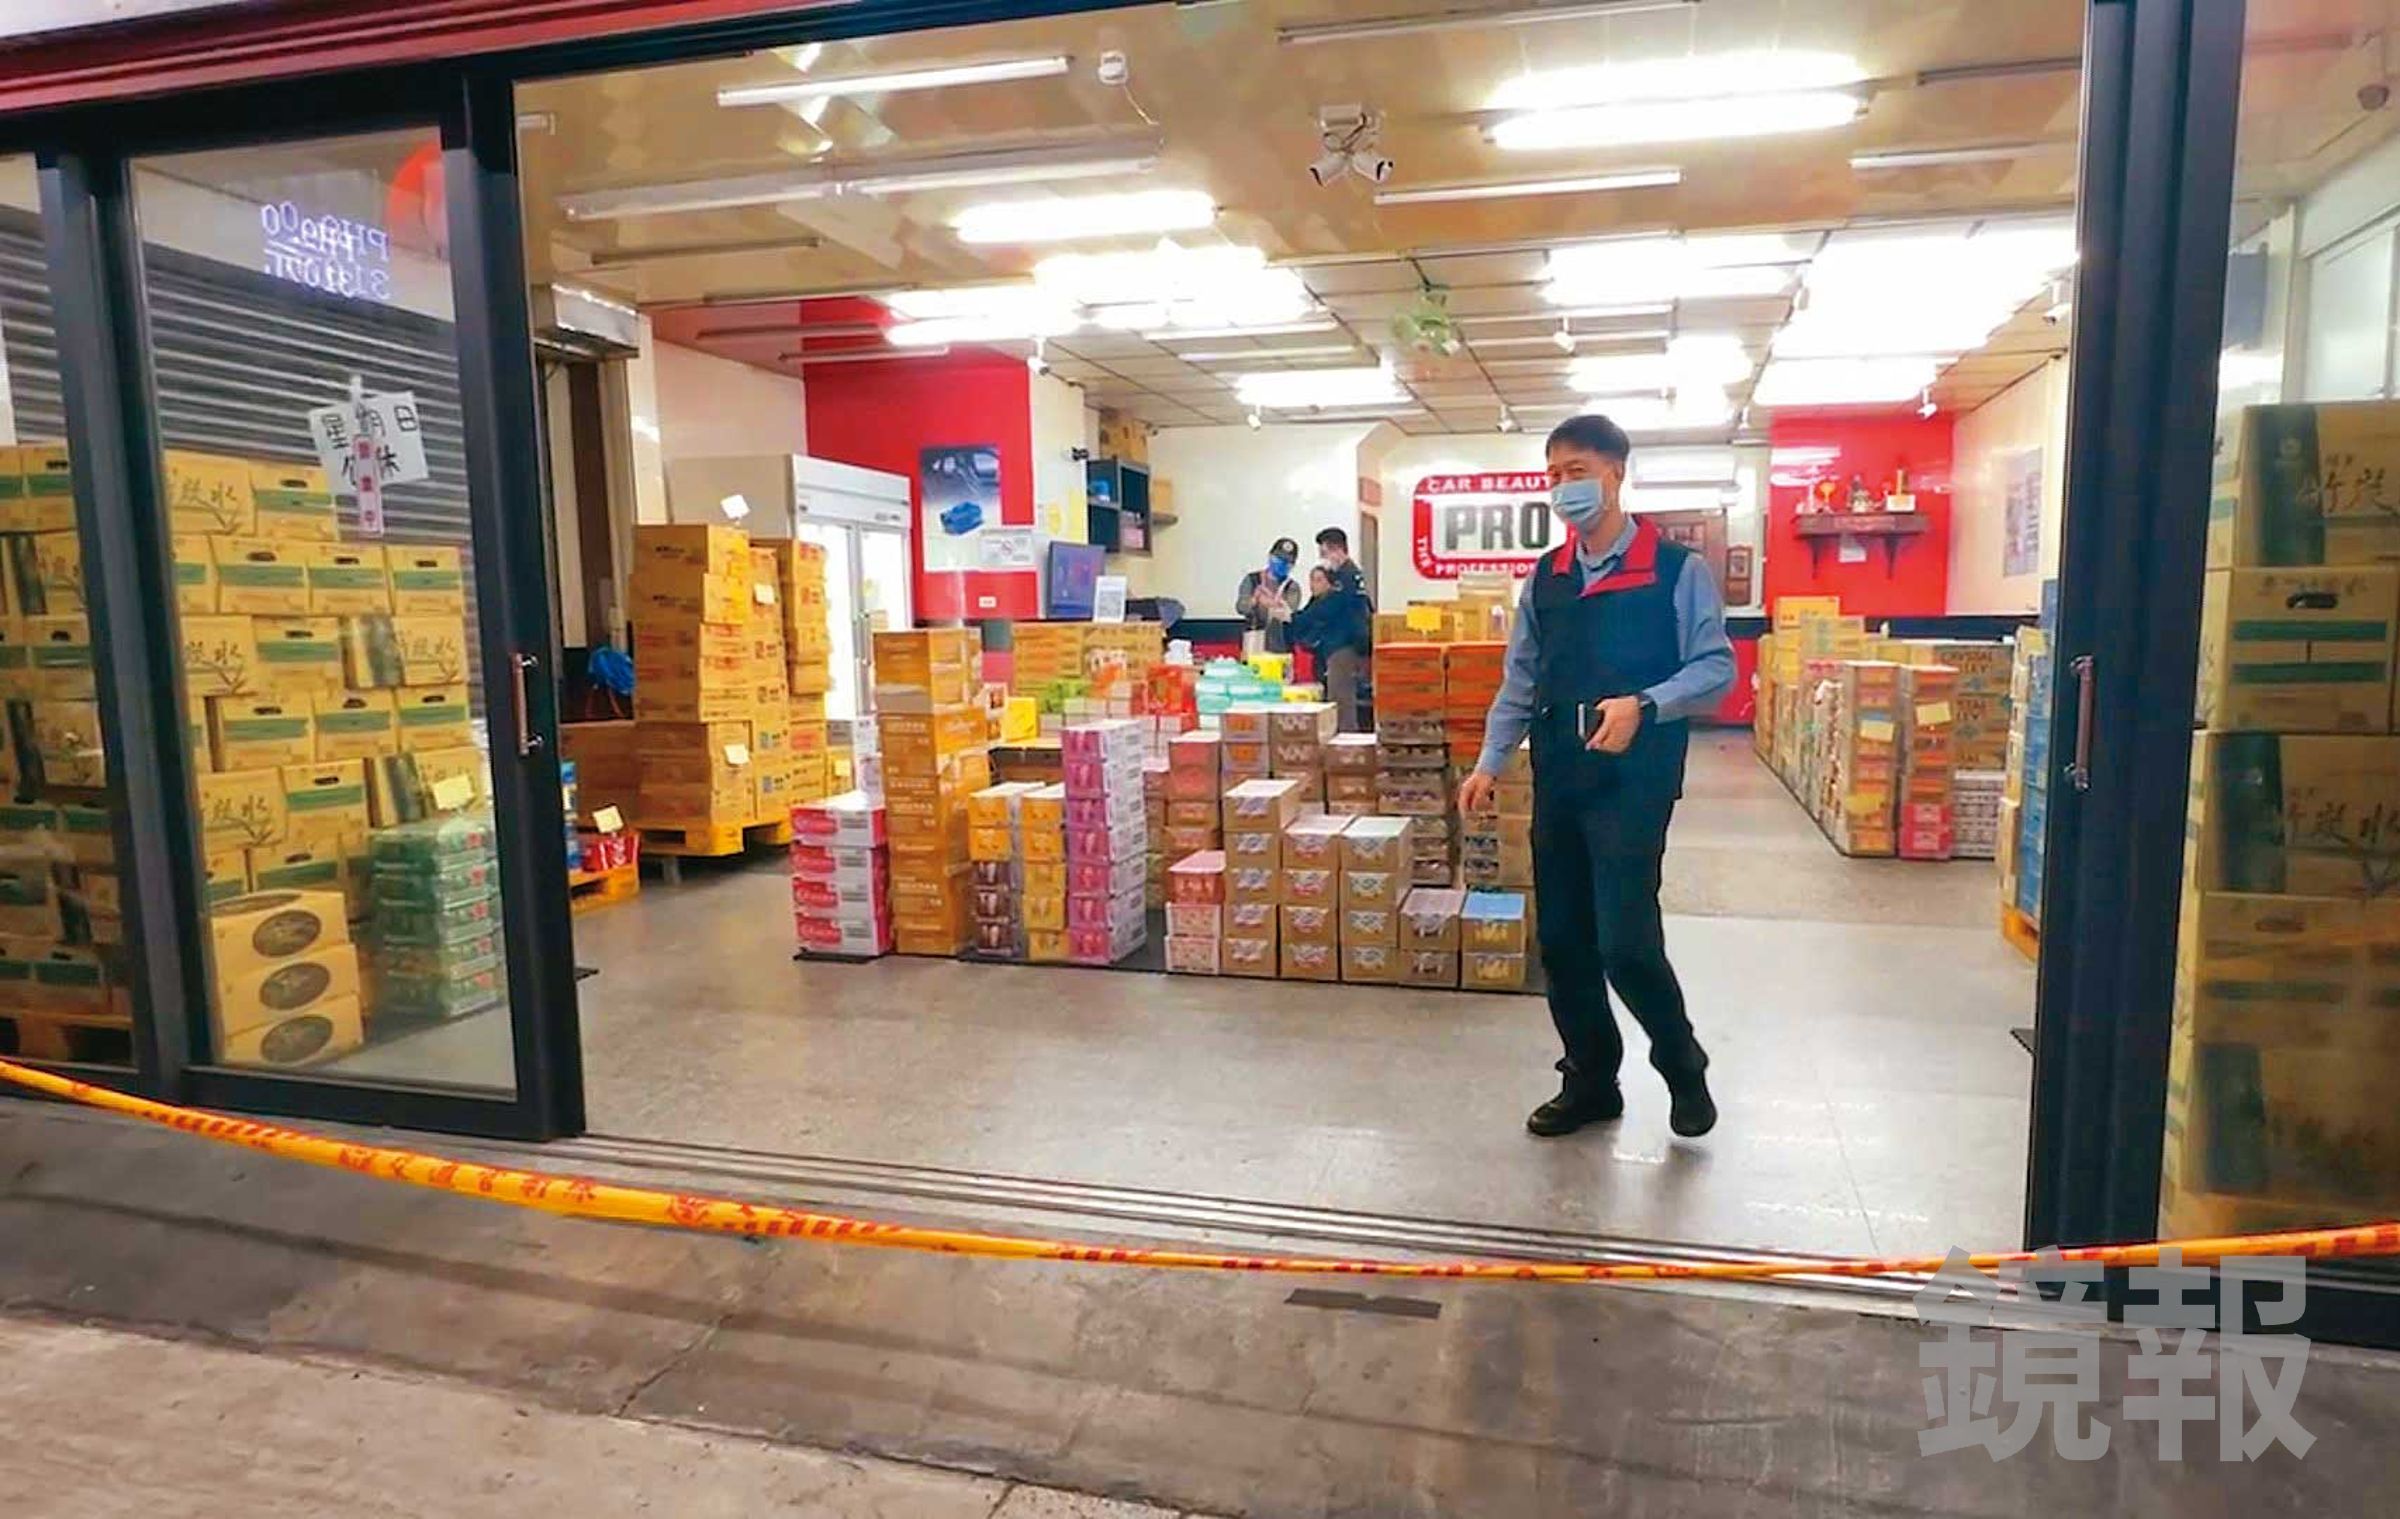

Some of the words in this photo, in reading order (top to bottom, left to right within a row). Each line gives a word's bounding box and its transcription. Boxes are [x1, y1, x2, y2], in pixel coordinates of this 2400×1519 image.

[1428, 477, 1471, 493] CAR
[1481, 475, 1550, 491] BEAUT
[1445, 501, 1550, 550] PRO
[1435, 562, 1534, 576] PROFESSIO
